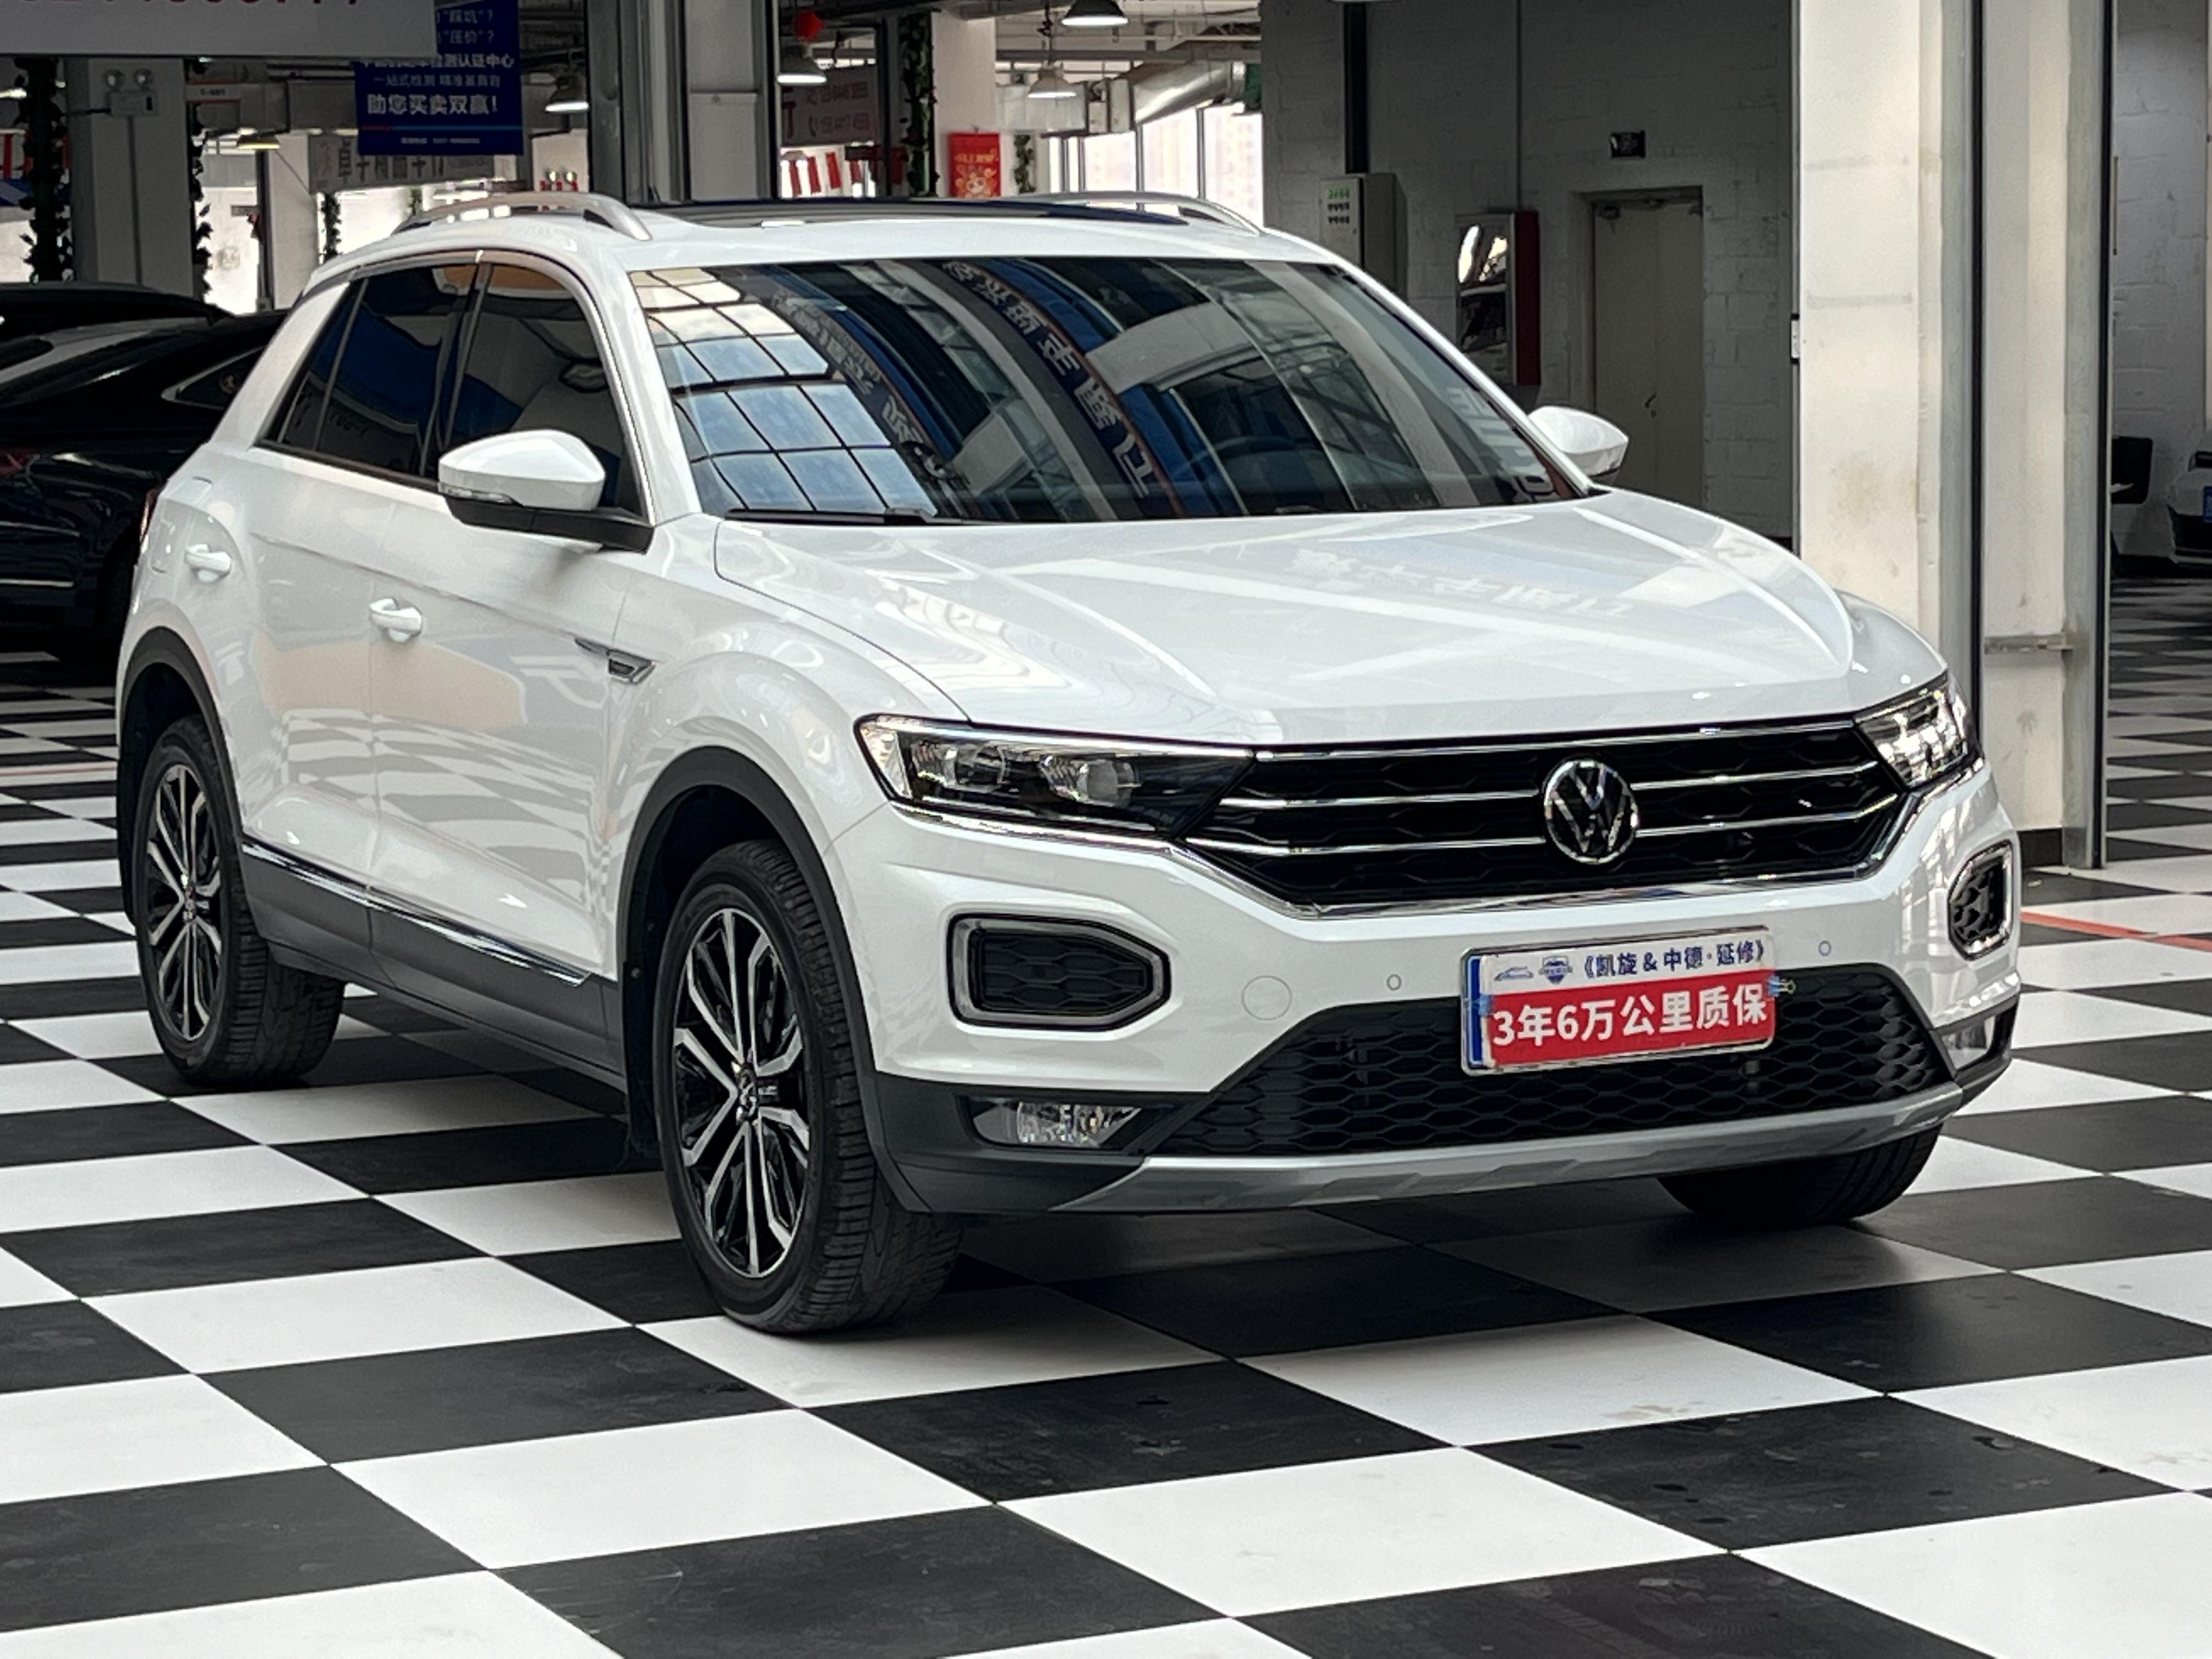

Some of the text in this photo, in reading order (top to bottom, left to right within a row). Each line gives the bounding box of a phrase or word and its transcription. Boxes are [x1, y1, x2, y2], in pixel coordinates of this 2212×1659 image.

[1492, 982, 1768, 1047] 3年6万公里质保
